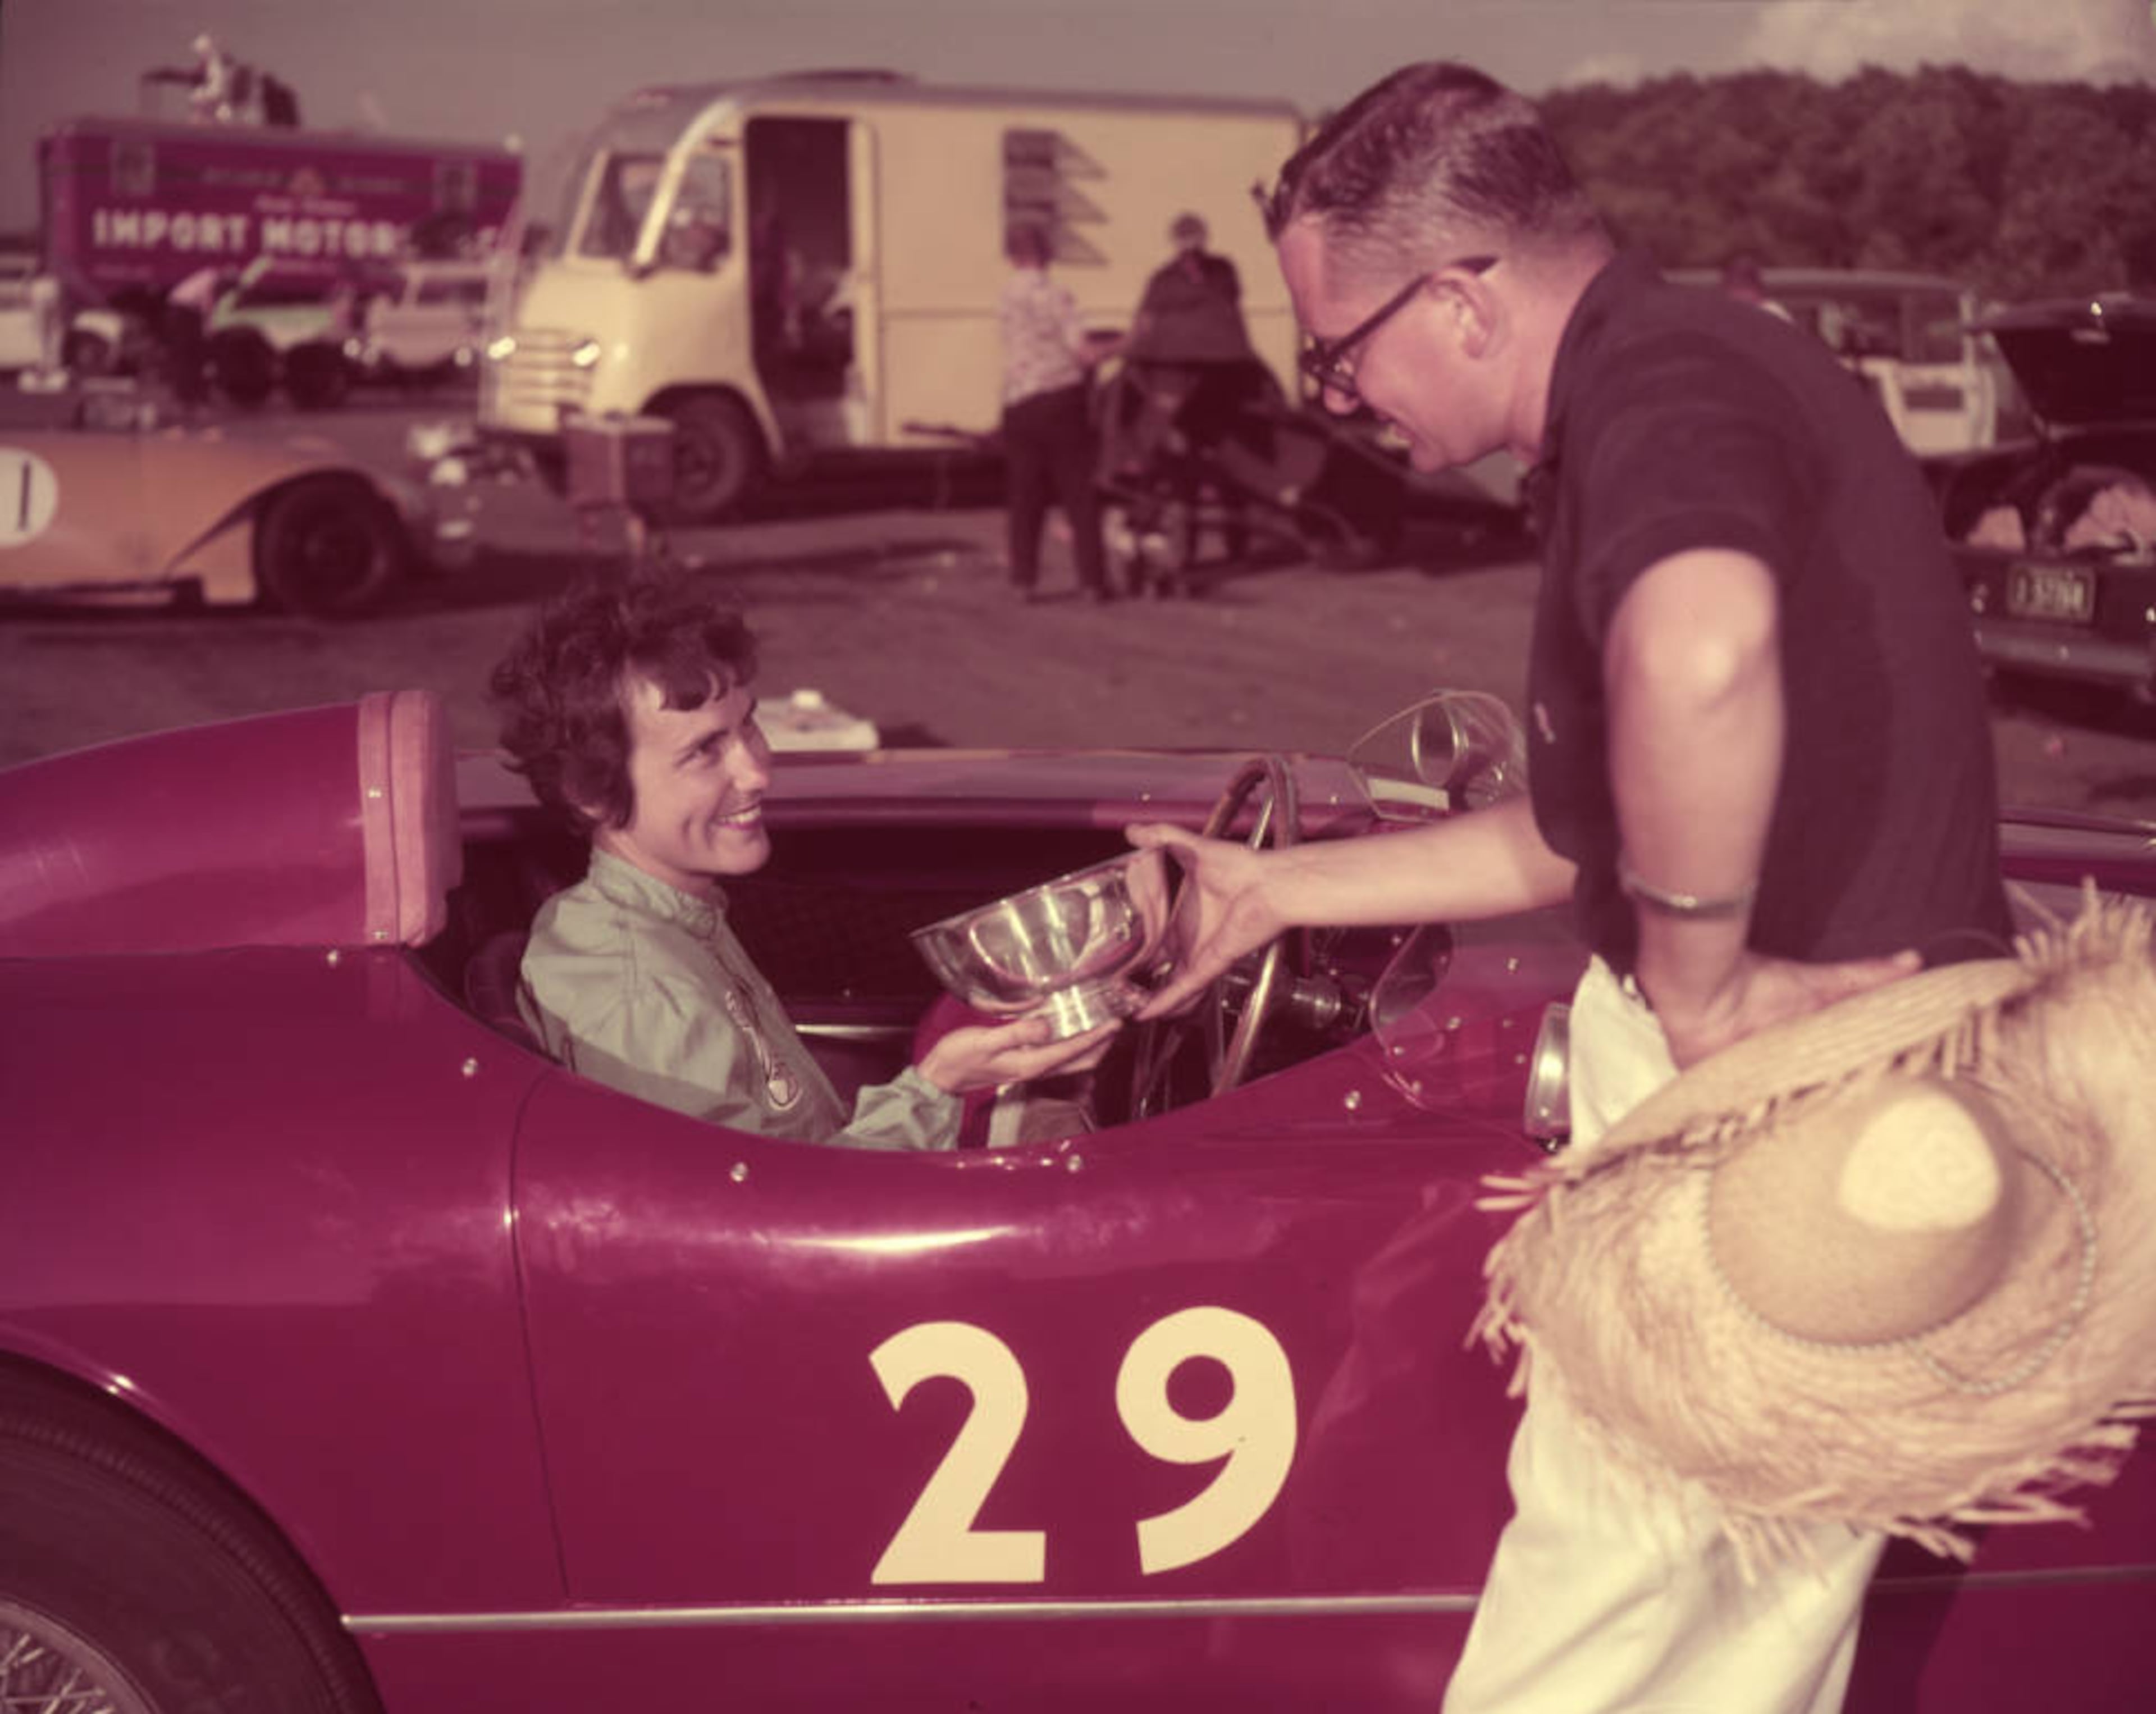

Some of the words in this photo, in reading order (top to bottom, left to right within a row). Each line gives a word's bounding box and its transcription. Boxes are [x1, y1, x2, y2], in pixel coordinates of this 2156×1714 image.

[93, 208, 249, 252] IMPORT
[261, 217, 405, 257] MOTOR
[869, 1306, 1298, 1585] 29
